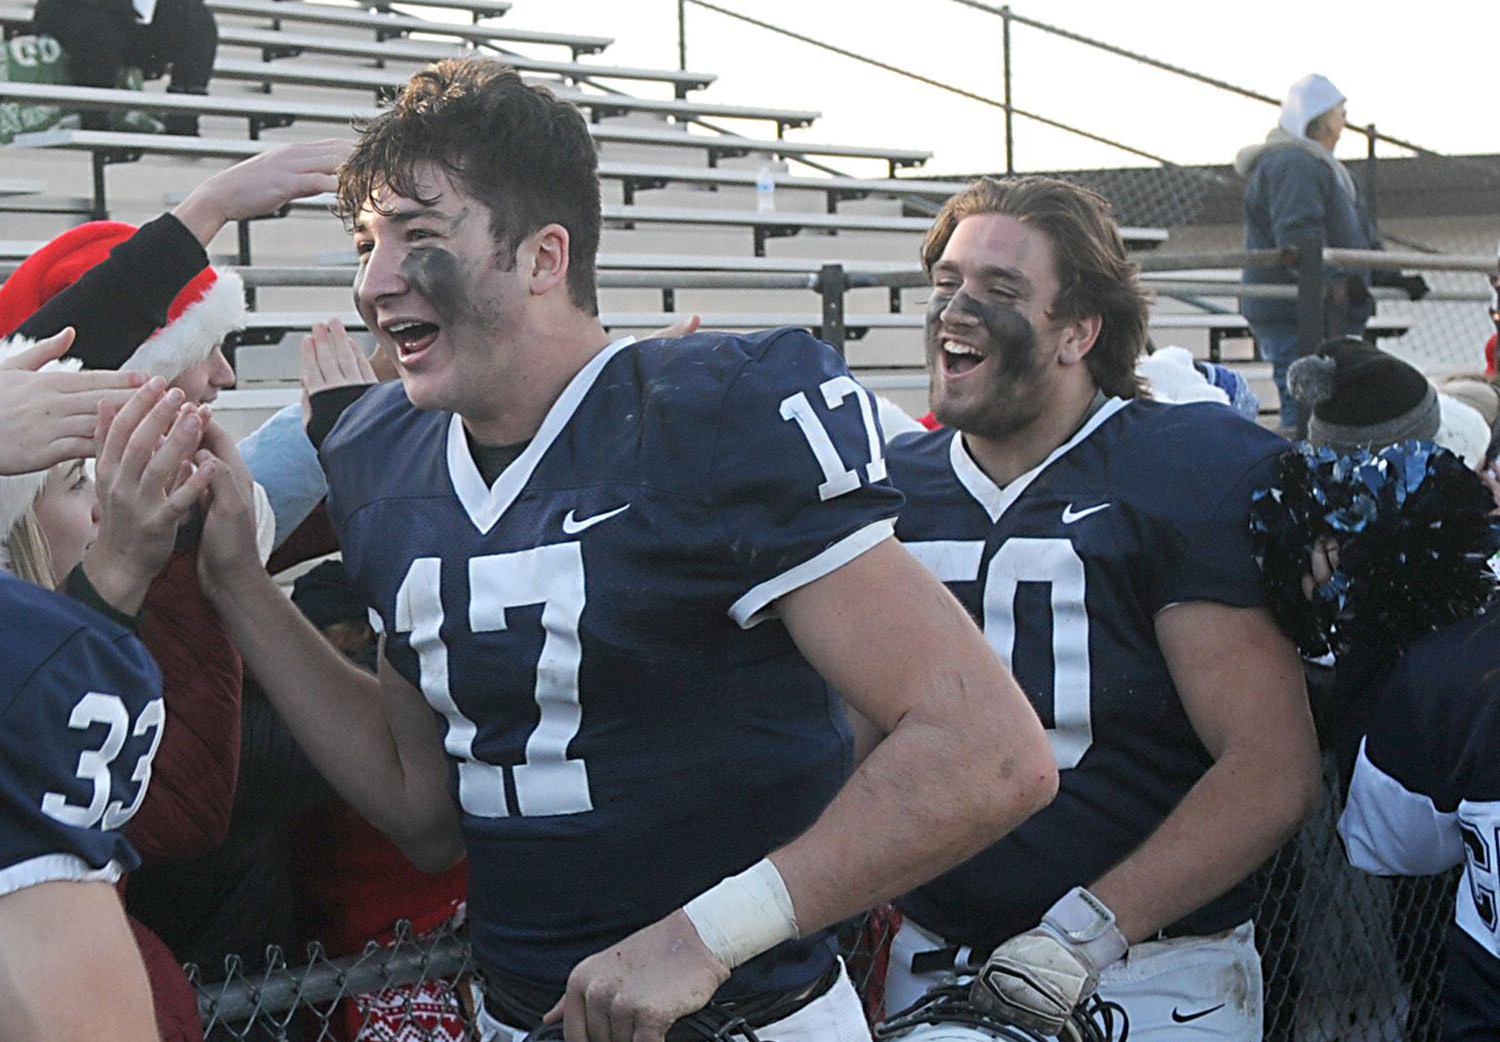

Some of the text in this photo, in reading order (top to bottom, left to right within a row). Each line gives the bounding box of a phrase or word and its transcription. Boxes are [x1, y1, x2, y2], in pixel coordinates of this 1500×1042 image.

[779, 375, 888, 502] 17
[395, 540, 594, 818] 17
[898, 536, 1094, 771] 0
[41, 692, 166, 831] 33
